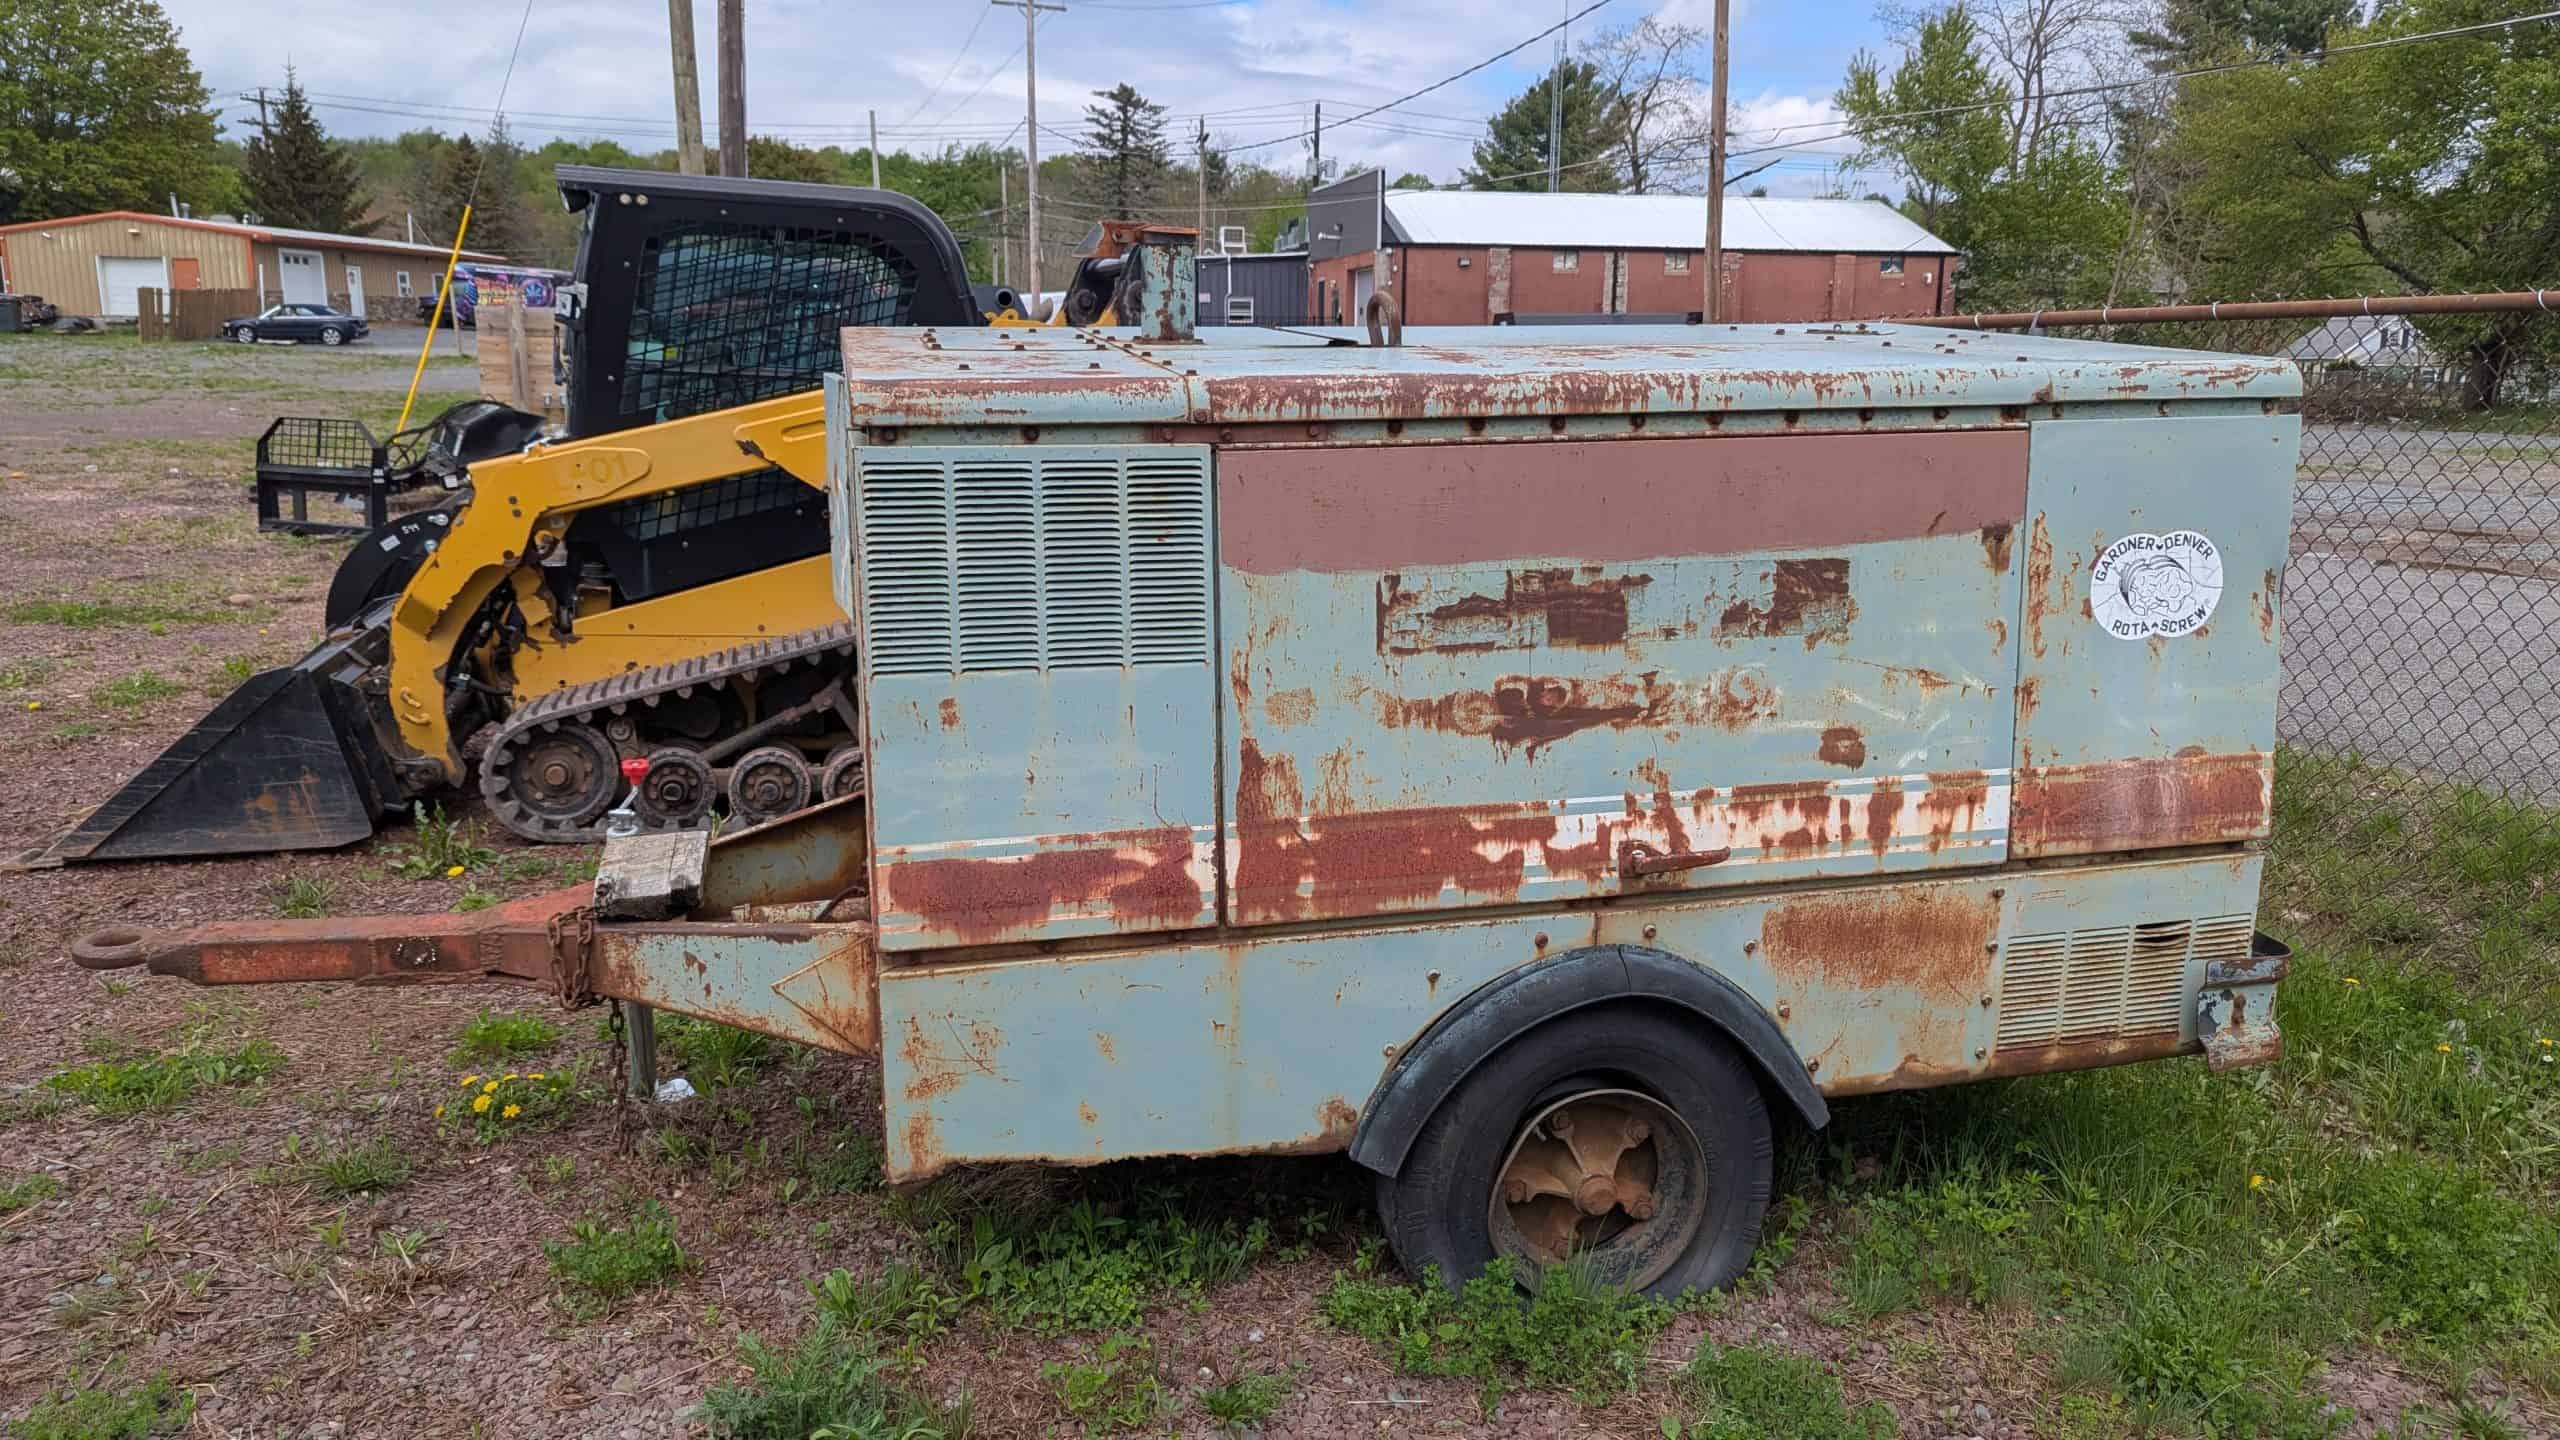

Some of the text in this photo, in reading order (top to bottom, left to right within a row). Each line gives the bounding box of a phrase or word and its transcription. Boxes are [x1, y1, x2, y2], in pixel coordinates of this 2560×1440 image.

[2095, 533, 2214, 582] GARDNER DENVER
[2112, 604, 2207, 636] ROTA SCREW
